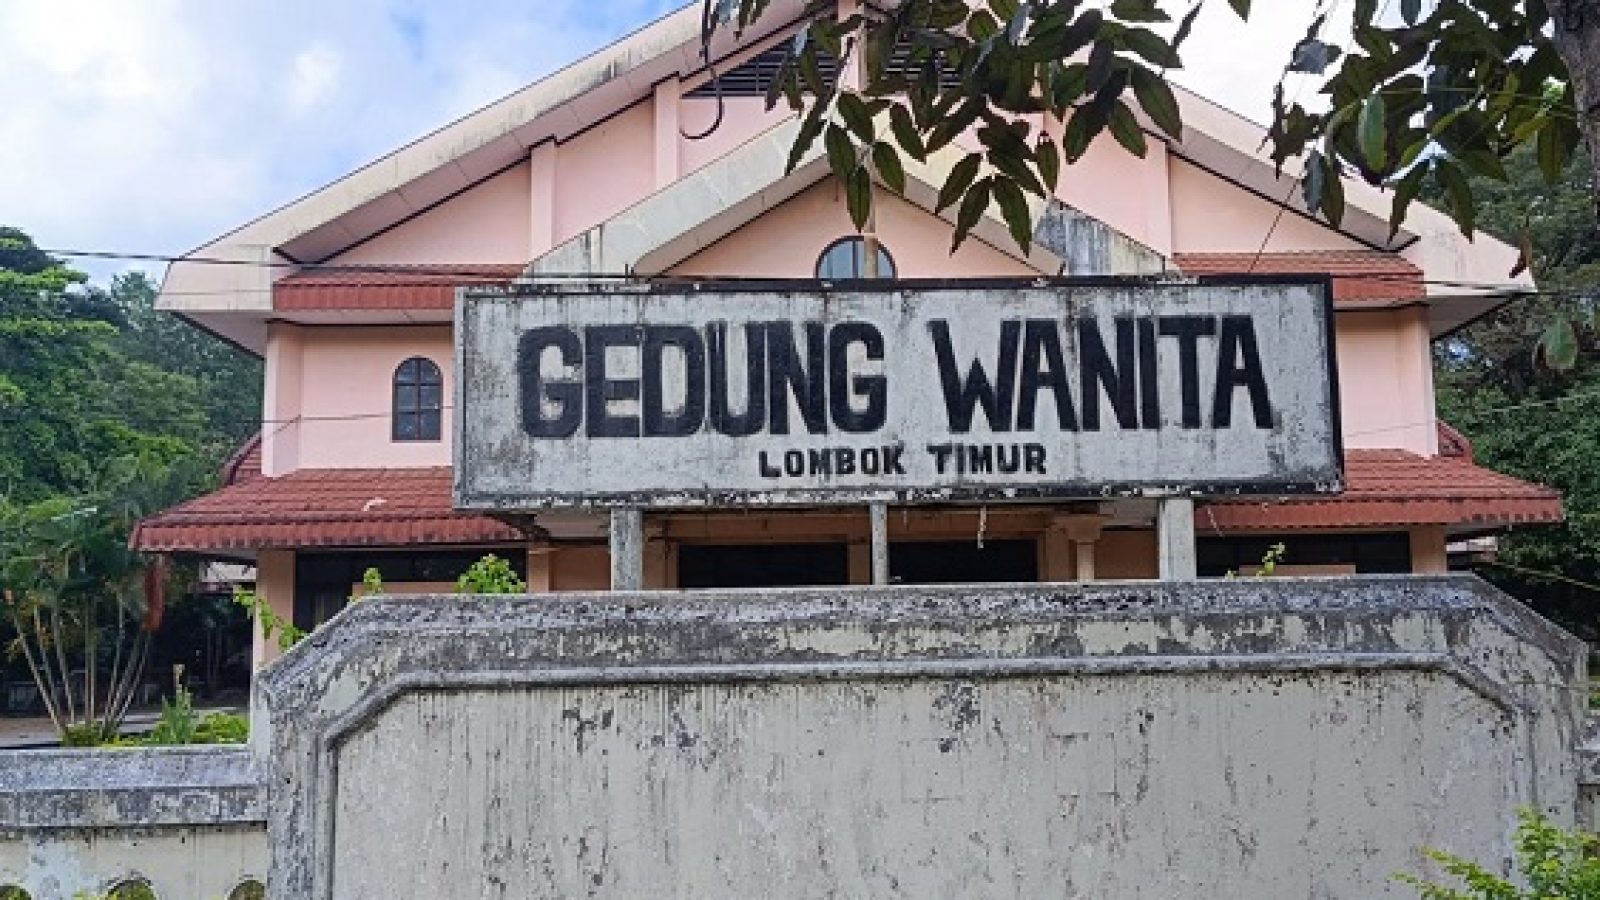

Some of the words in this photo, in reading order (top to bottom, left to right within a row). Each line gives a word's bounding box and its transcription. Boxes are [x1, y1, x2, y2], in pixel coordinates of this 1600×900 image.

[518, 321, 887, 438] GEDUNG
[929, 313, 1274, 433] WANITA
[759, 443, 906, 478] LOMBOK
[927, 443, 1047, 475] TIMUR
